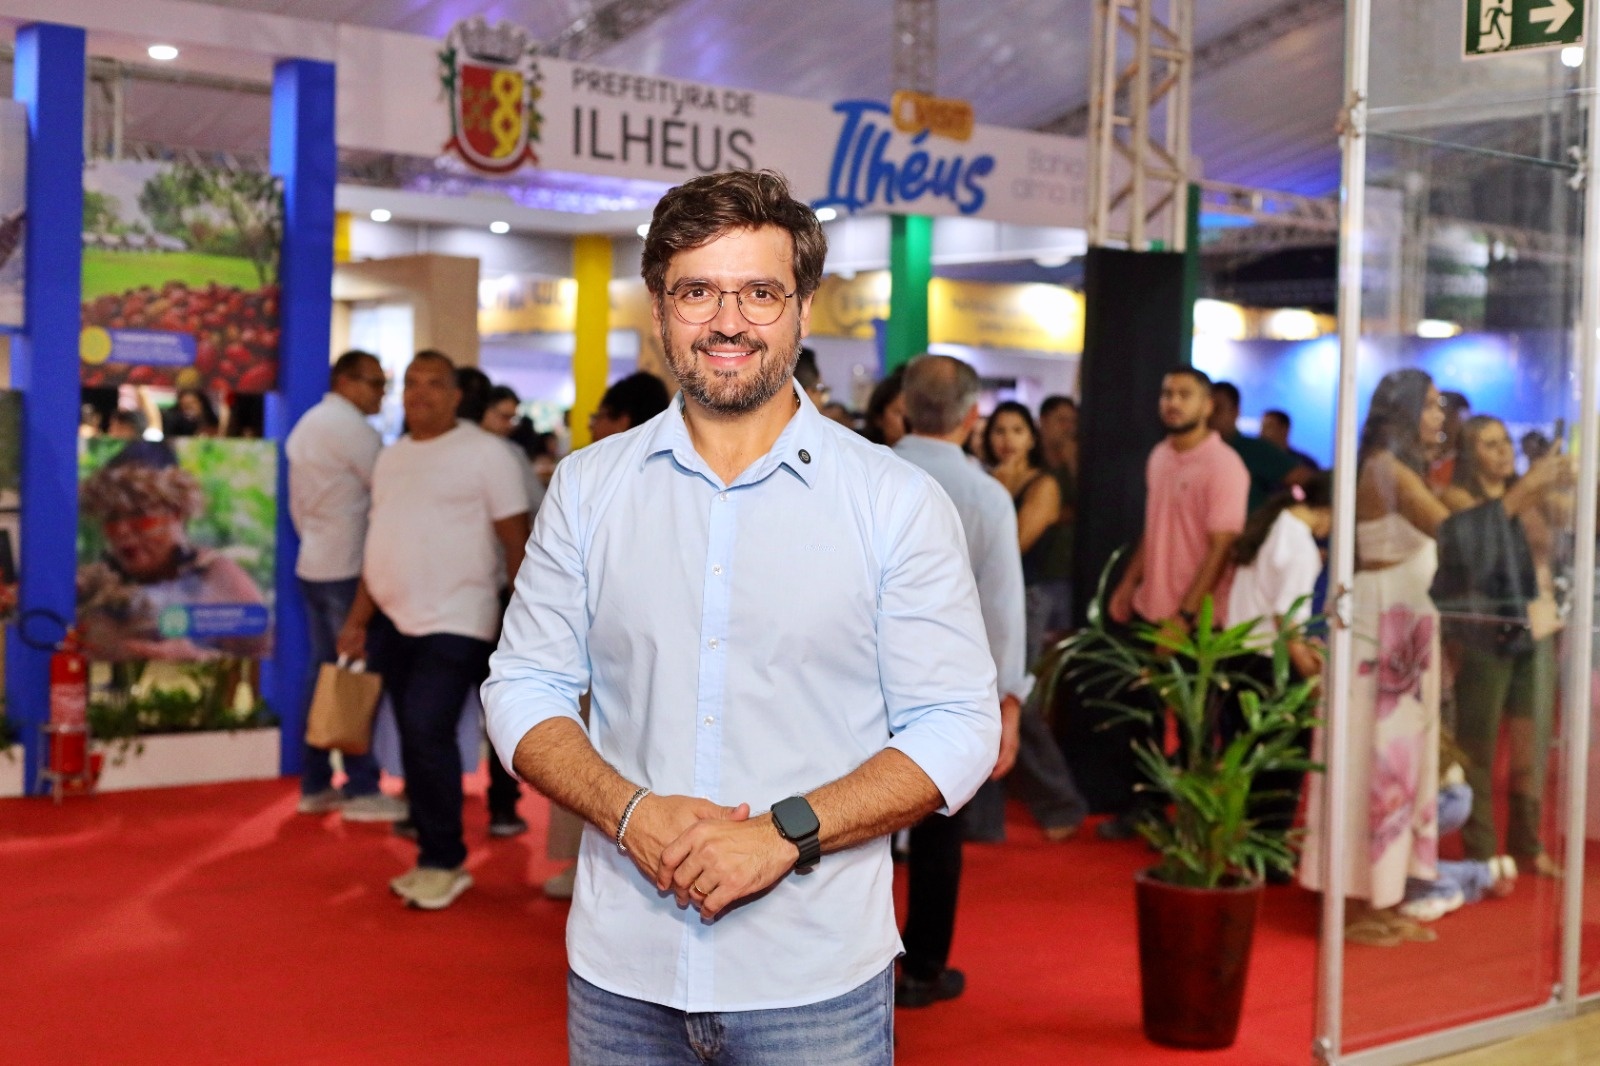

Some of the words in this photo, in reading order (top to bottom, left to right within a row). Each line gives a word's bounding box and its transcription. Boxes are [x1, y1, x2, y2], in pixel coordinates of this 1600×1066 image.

[572, 67, 719, 112] PREFEITURA
[722, 90, 755, 117] DE
[573, 100, 755, 172] ILHÉUS
[810, 99, 996, 215] Ilhéus
